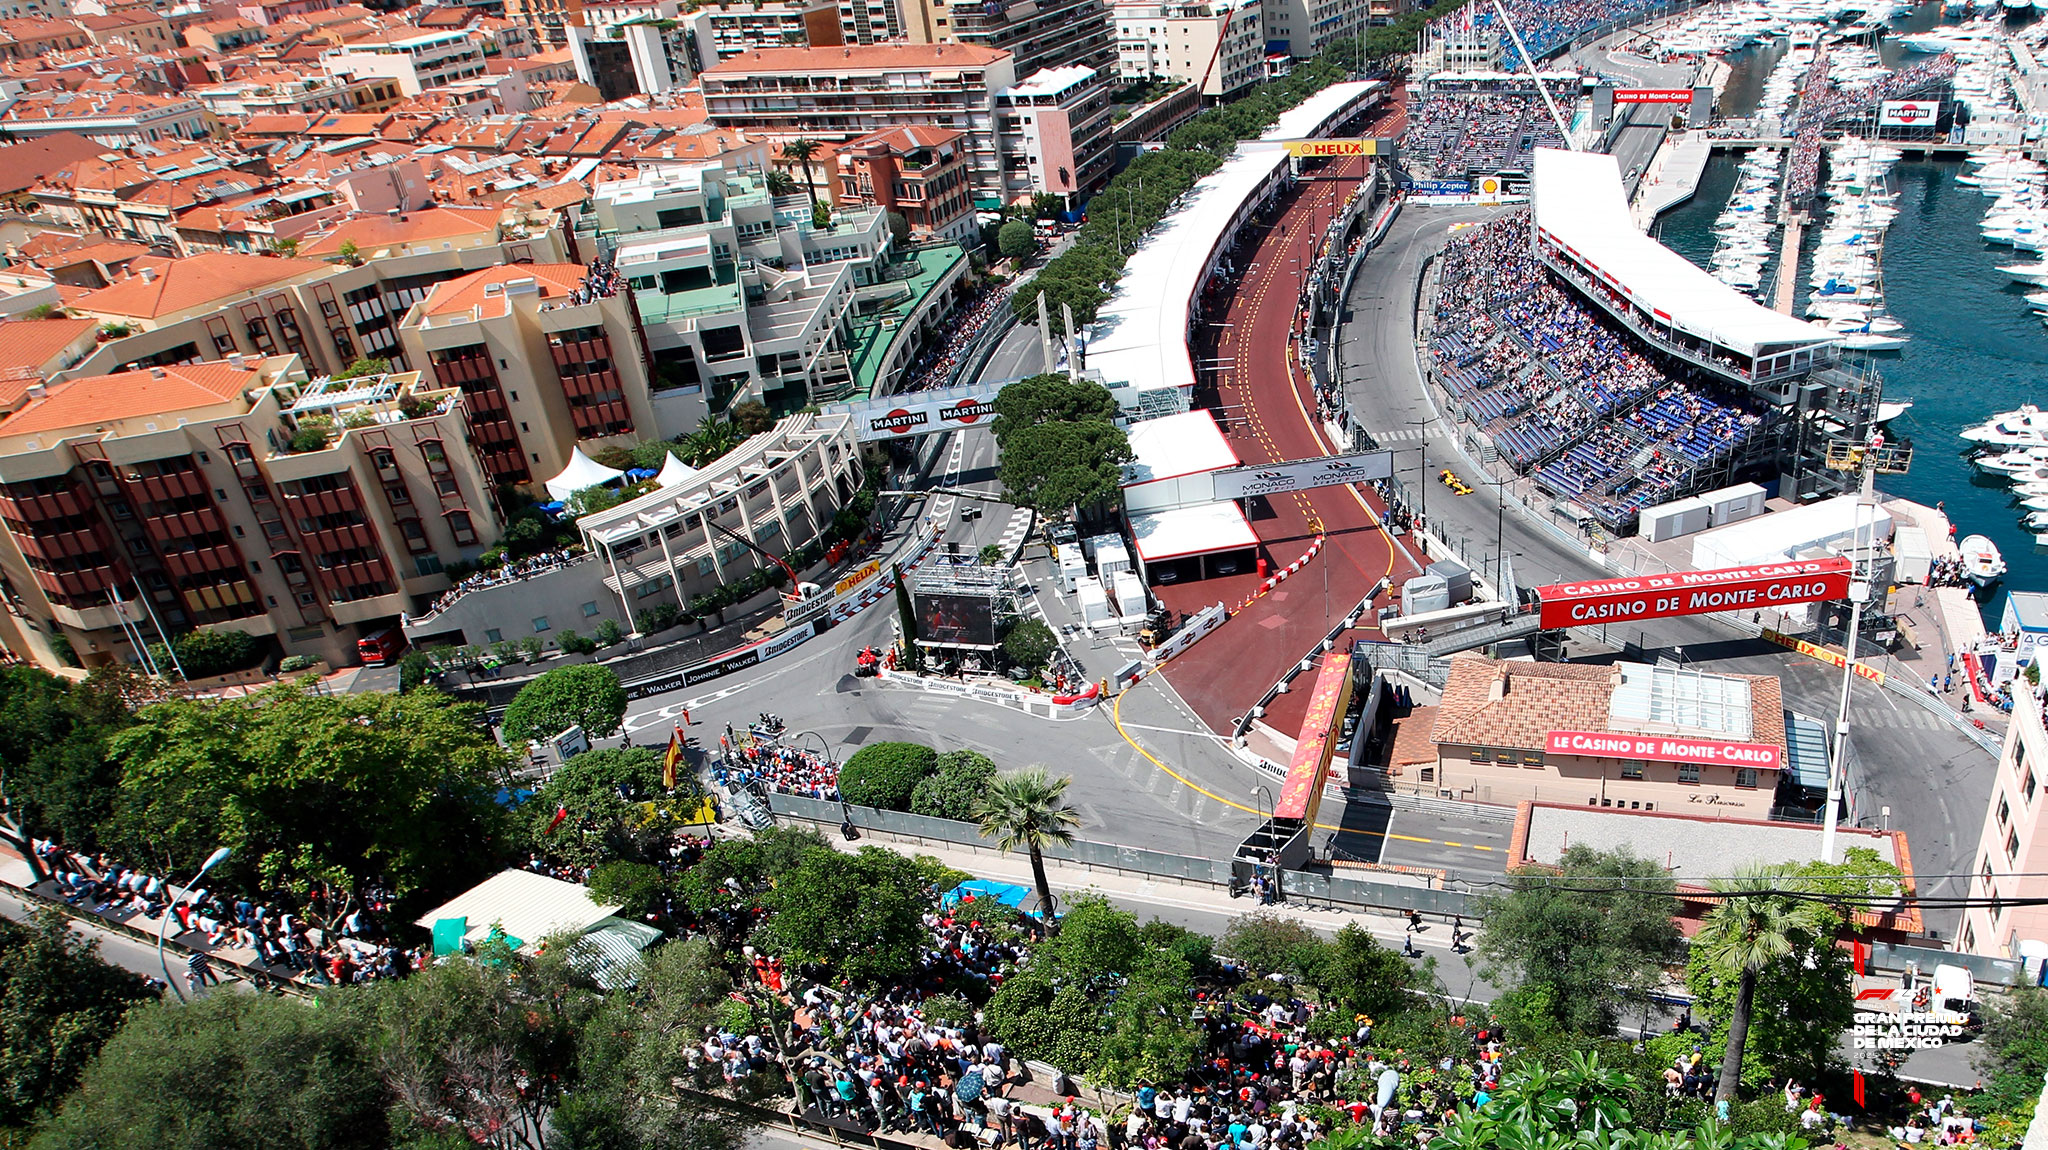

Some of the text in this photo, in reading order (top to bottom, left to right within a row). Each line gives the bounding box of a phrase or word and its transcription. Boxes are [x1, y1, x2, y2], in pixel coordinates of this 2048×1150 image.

[1889, 109, 1928, 117] MARTINI
[1314, 143, 1363, 155] HELIX
[1413, 182, 1468, 190] Philip Zepter
[942, 403, 993, 419] MARTINI
[873, 414, 925, 429] MARTINI
[1313, 468, 1365, 482] MONACO
[1242, 478, 1295, 491] MONACO
[848, 565, 877, 588] HELIX
[1563, 562, 1821, 596] CASINO DE MONTE-CARLO
[786, 588, 836, 622] BRIDGESTONE
[1571, 581, 1827, 621] CASINO DE MONTE-CARLO
[764, 628, 809, 657] BRIDGESTONE
[1775, 633, 1816, 657] HELIX
[687, 655, 757, 684] JOHNNIE WALKER
[1834, 656, 1879, 682] HLIX
[646, 680, 682, 695] WALKER
[972, 688, 1012, 700] BRIDGESTONE
[1553, 735, 1773, 763] LE CASINO DE MONTE-CARLO
[1687, 793, 1702, 804] La
